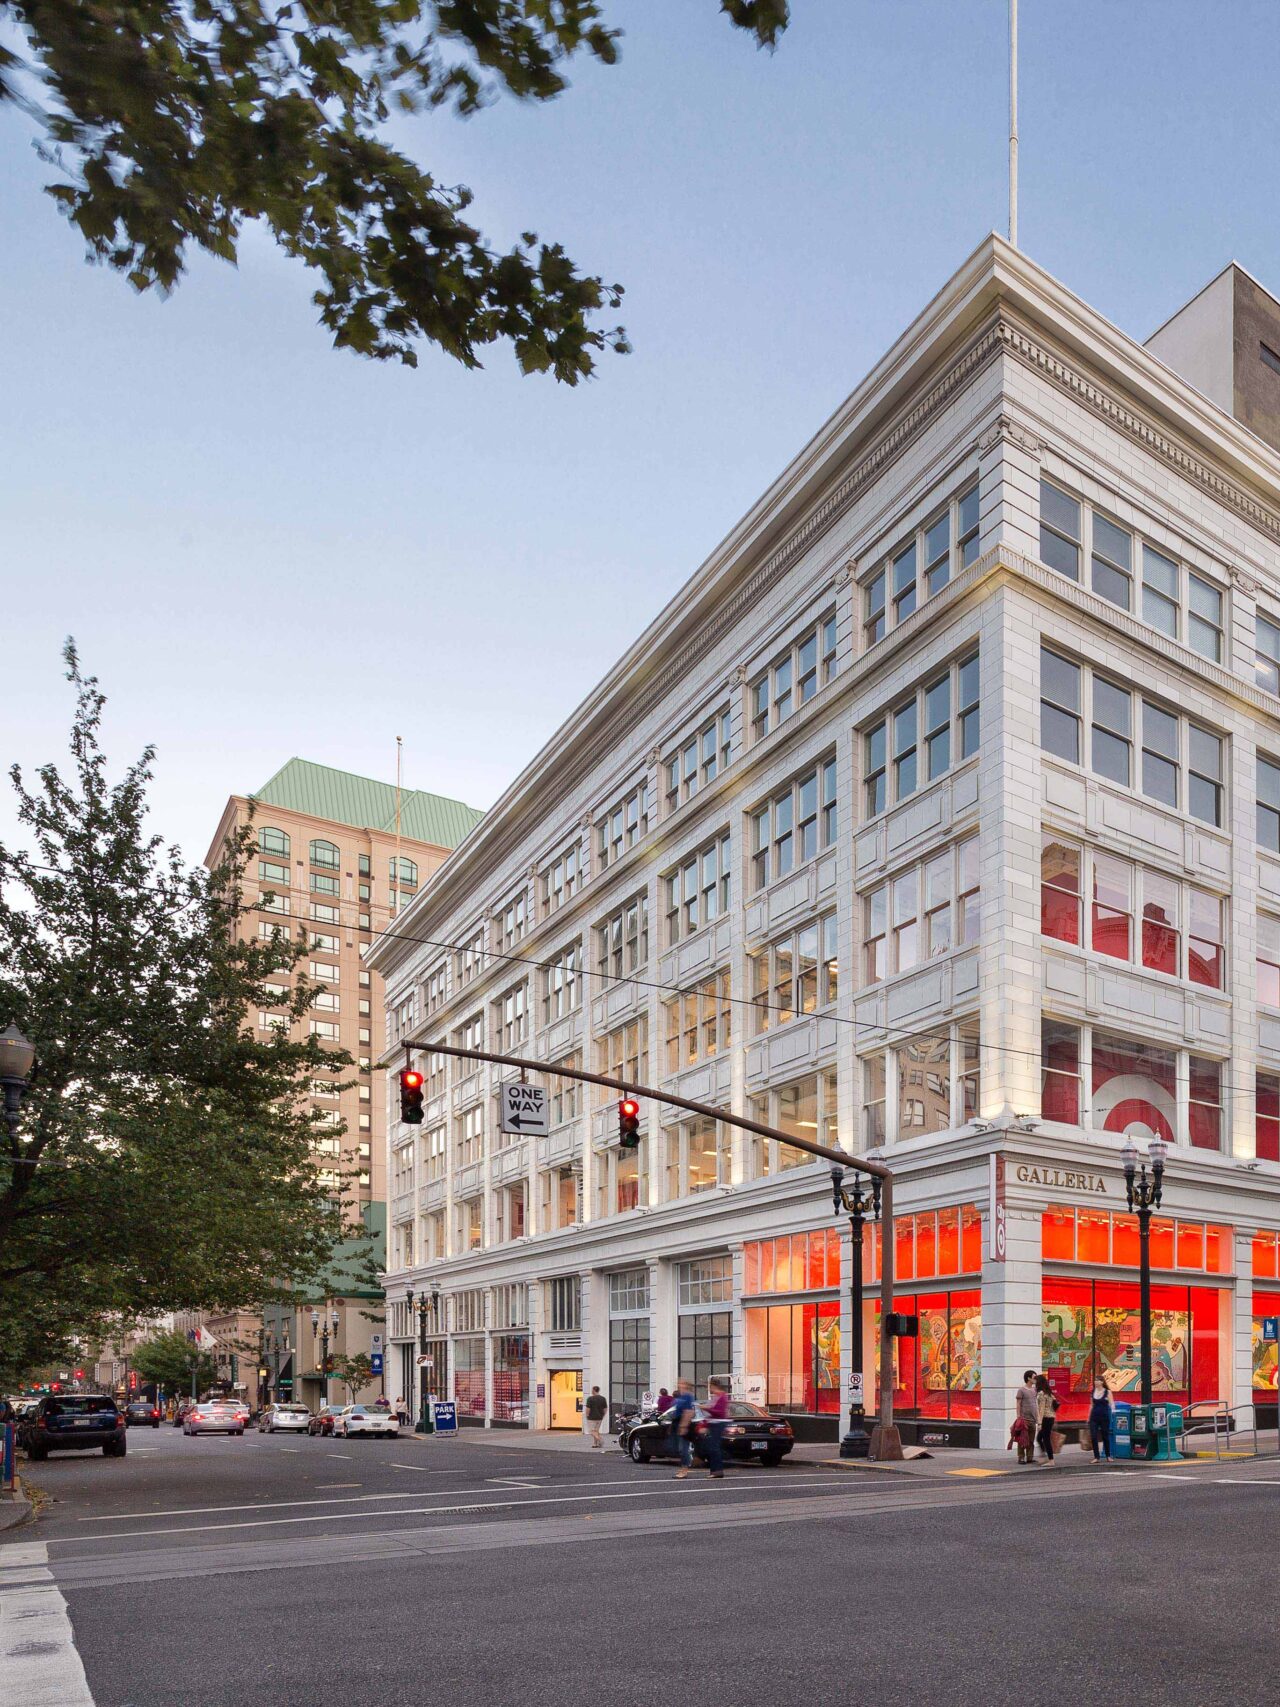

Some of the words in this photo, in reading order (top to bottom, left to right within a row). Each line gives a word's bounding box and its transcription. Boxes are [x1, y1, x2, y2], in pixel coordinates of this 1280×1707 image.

[508, 1087, 543, 1100] ONE
[508, 1100, 544, 1113] WAY
[1016, 1166, 1107, 1192] GALLERIA
